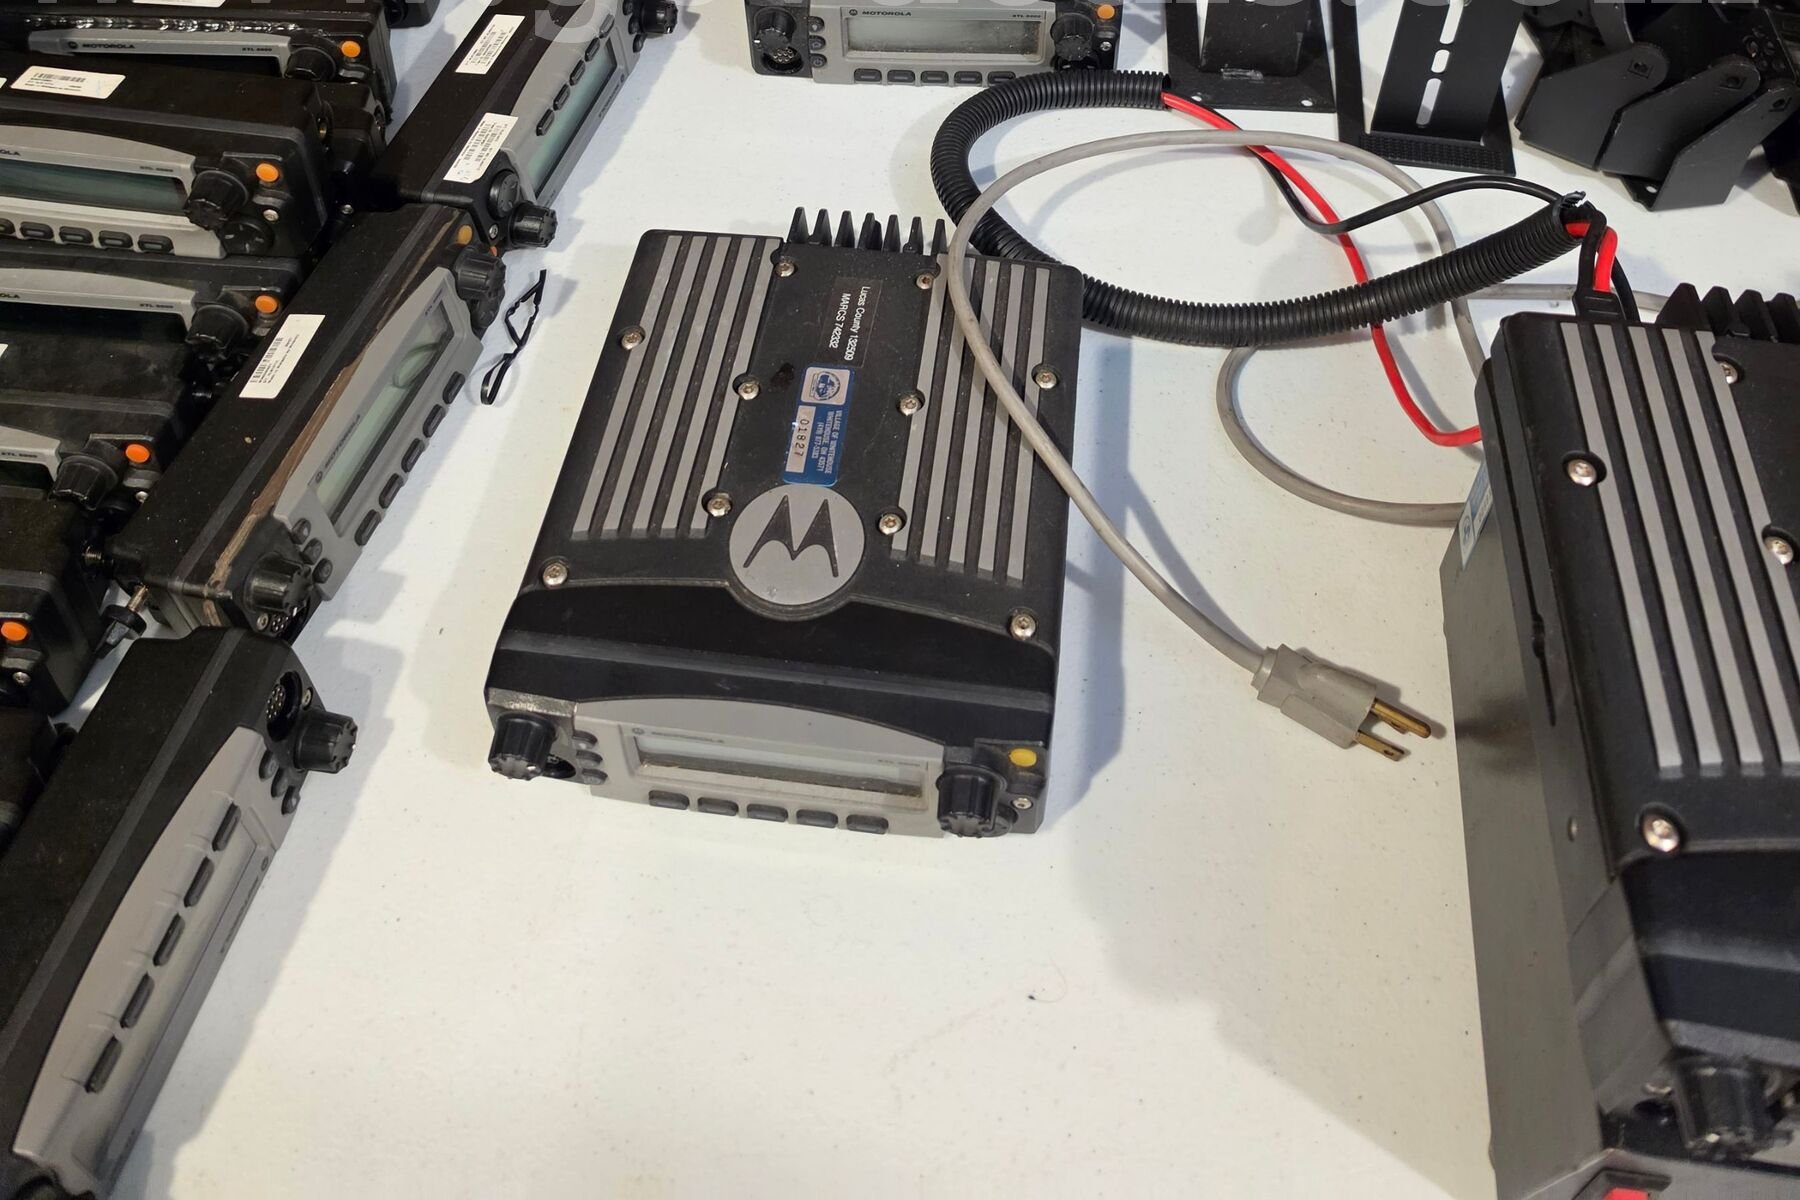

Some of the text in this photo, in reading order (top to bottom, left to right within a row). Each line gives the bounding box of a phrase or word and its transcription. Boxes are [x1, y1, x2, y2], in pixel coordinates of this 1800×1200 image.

[835, 293, 852, 321] MARCS
[844, 286, 871, 361] Lucas County 132509
[794, 418, 810, 457] 01827
[824, 410, 842, 474] VILLAGE OF WHITEHOUSE
